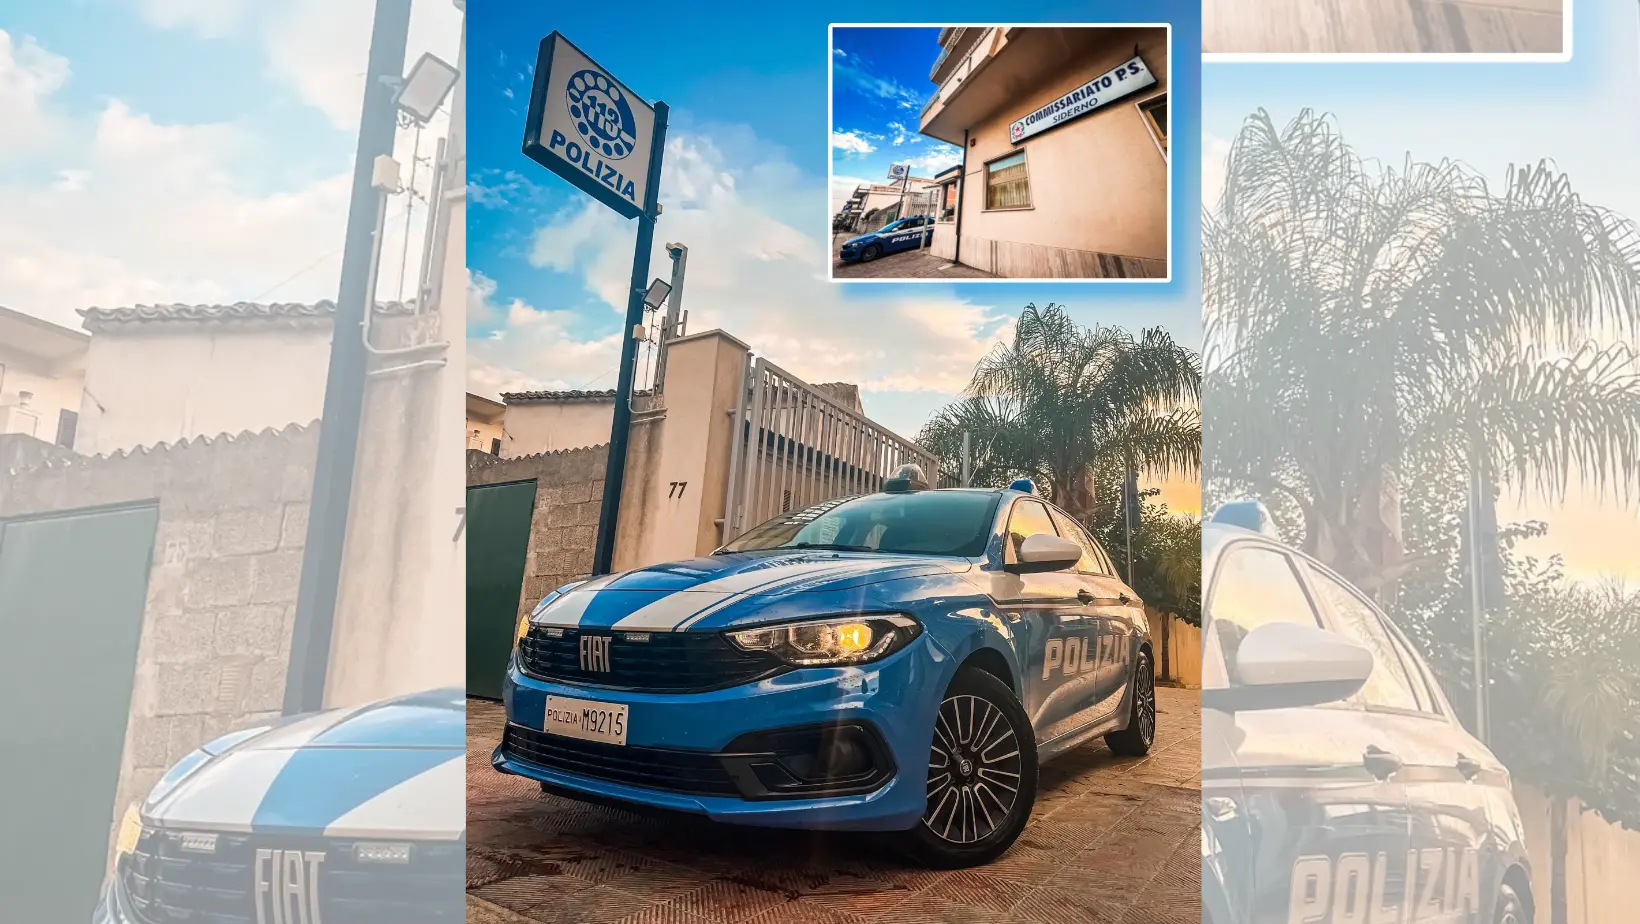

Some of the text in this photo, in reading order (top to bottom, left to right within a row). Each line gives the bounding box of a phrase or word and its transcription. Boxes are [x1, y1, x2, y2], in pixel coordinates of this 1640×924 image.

[1025, 61, 1144, 126] COMMISSARIATO P.S.
[1053, 97, 1098, 124] SIDERNO
[587, 95, 619, 138] 113
[550, 129, 635, 202] POLIZIA
[669, 481, 687, 499] 77
[580, 635, 612, 673] FIAT
[1042, 634, 1130, 681] POLIZIA
[547, 708, 624, 736] POLIZIA M9215
[254, 848, 327, 924] FIAT
[1287, 847, 1480, 924] POLIZIA
